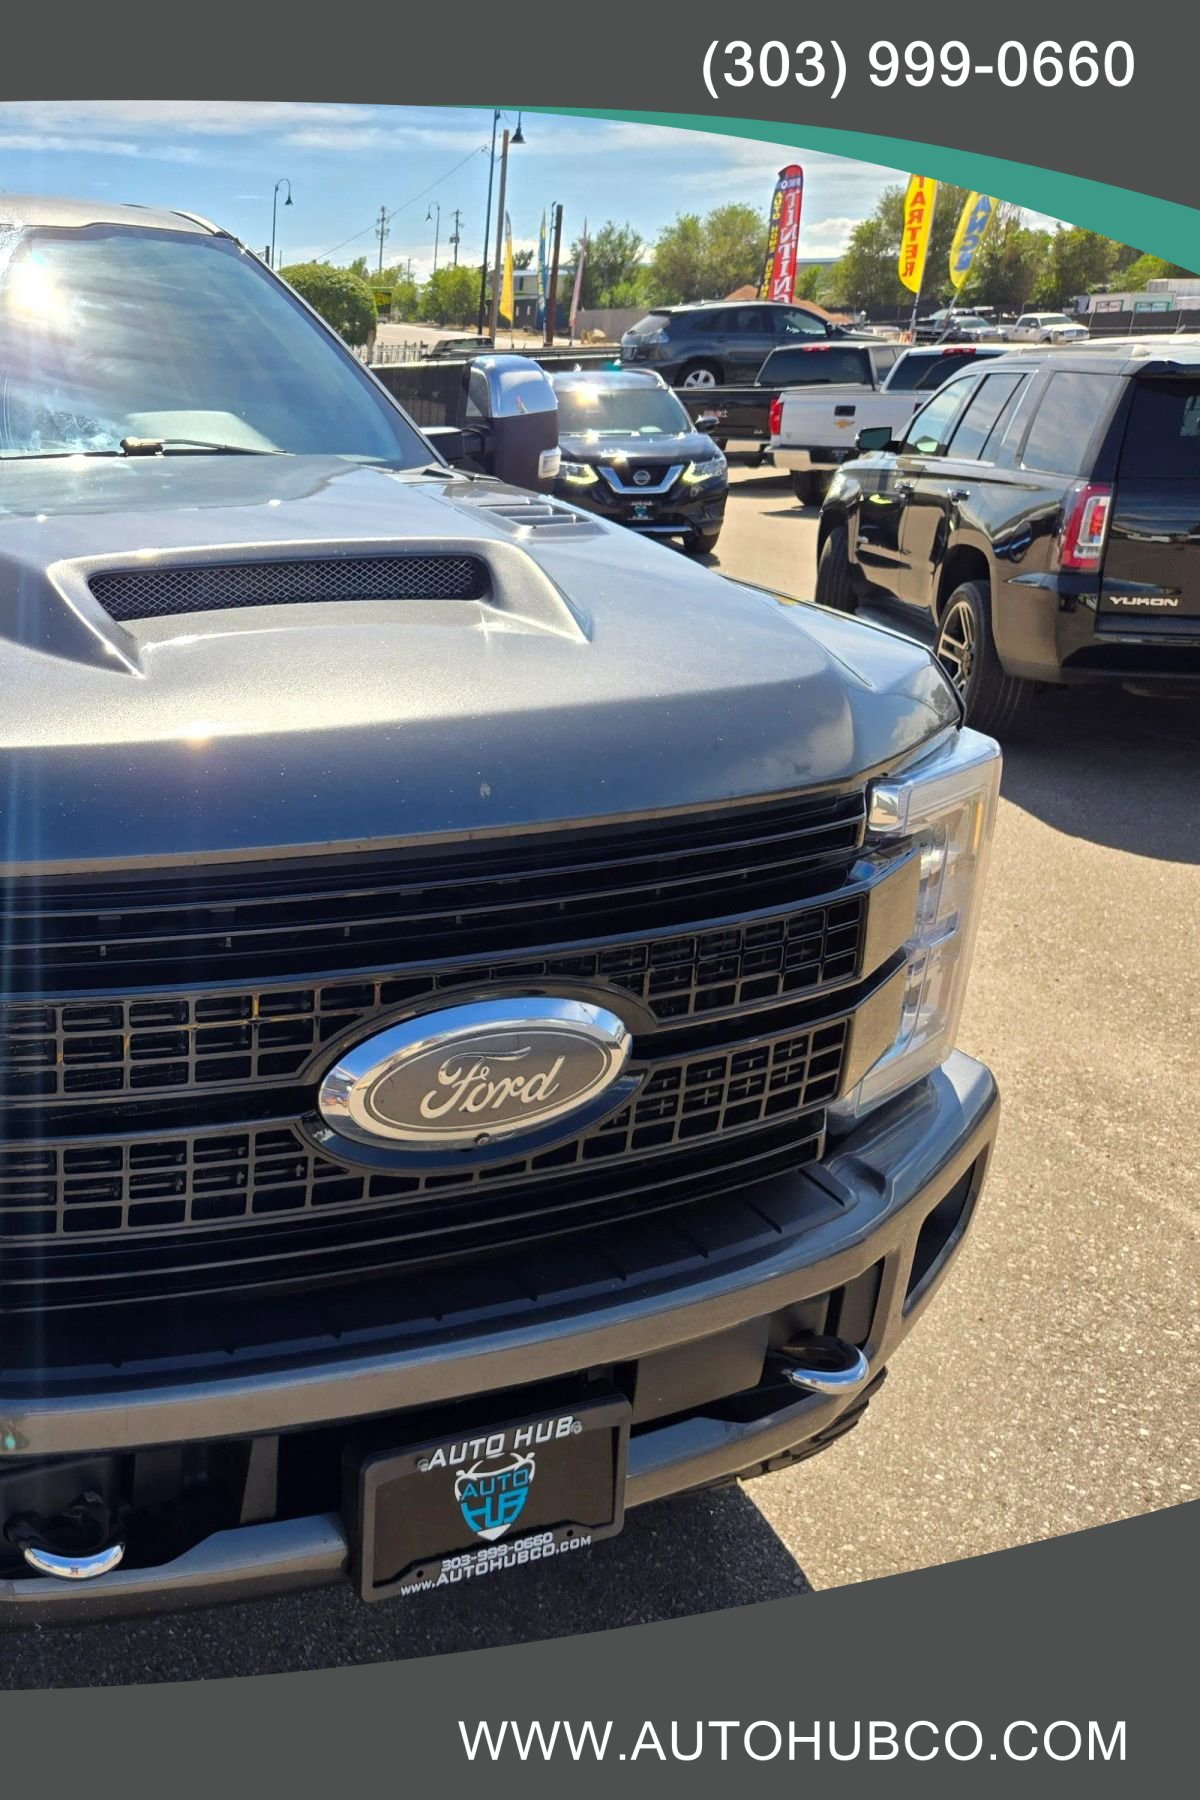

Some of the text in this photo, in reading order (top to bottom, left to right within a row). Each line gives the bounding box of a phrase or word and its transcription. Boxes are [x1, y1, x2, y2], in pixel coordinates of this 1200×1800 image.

[1109, 596, 1179, 607] YUKON
[419, 1046, 566, 1119] Ford
[427, 1415, 574, 1471] AUTO HUB
[461, 1468, 529, 1500] AUTO
[441, 1532, 553, 1573] 303-999-0660
